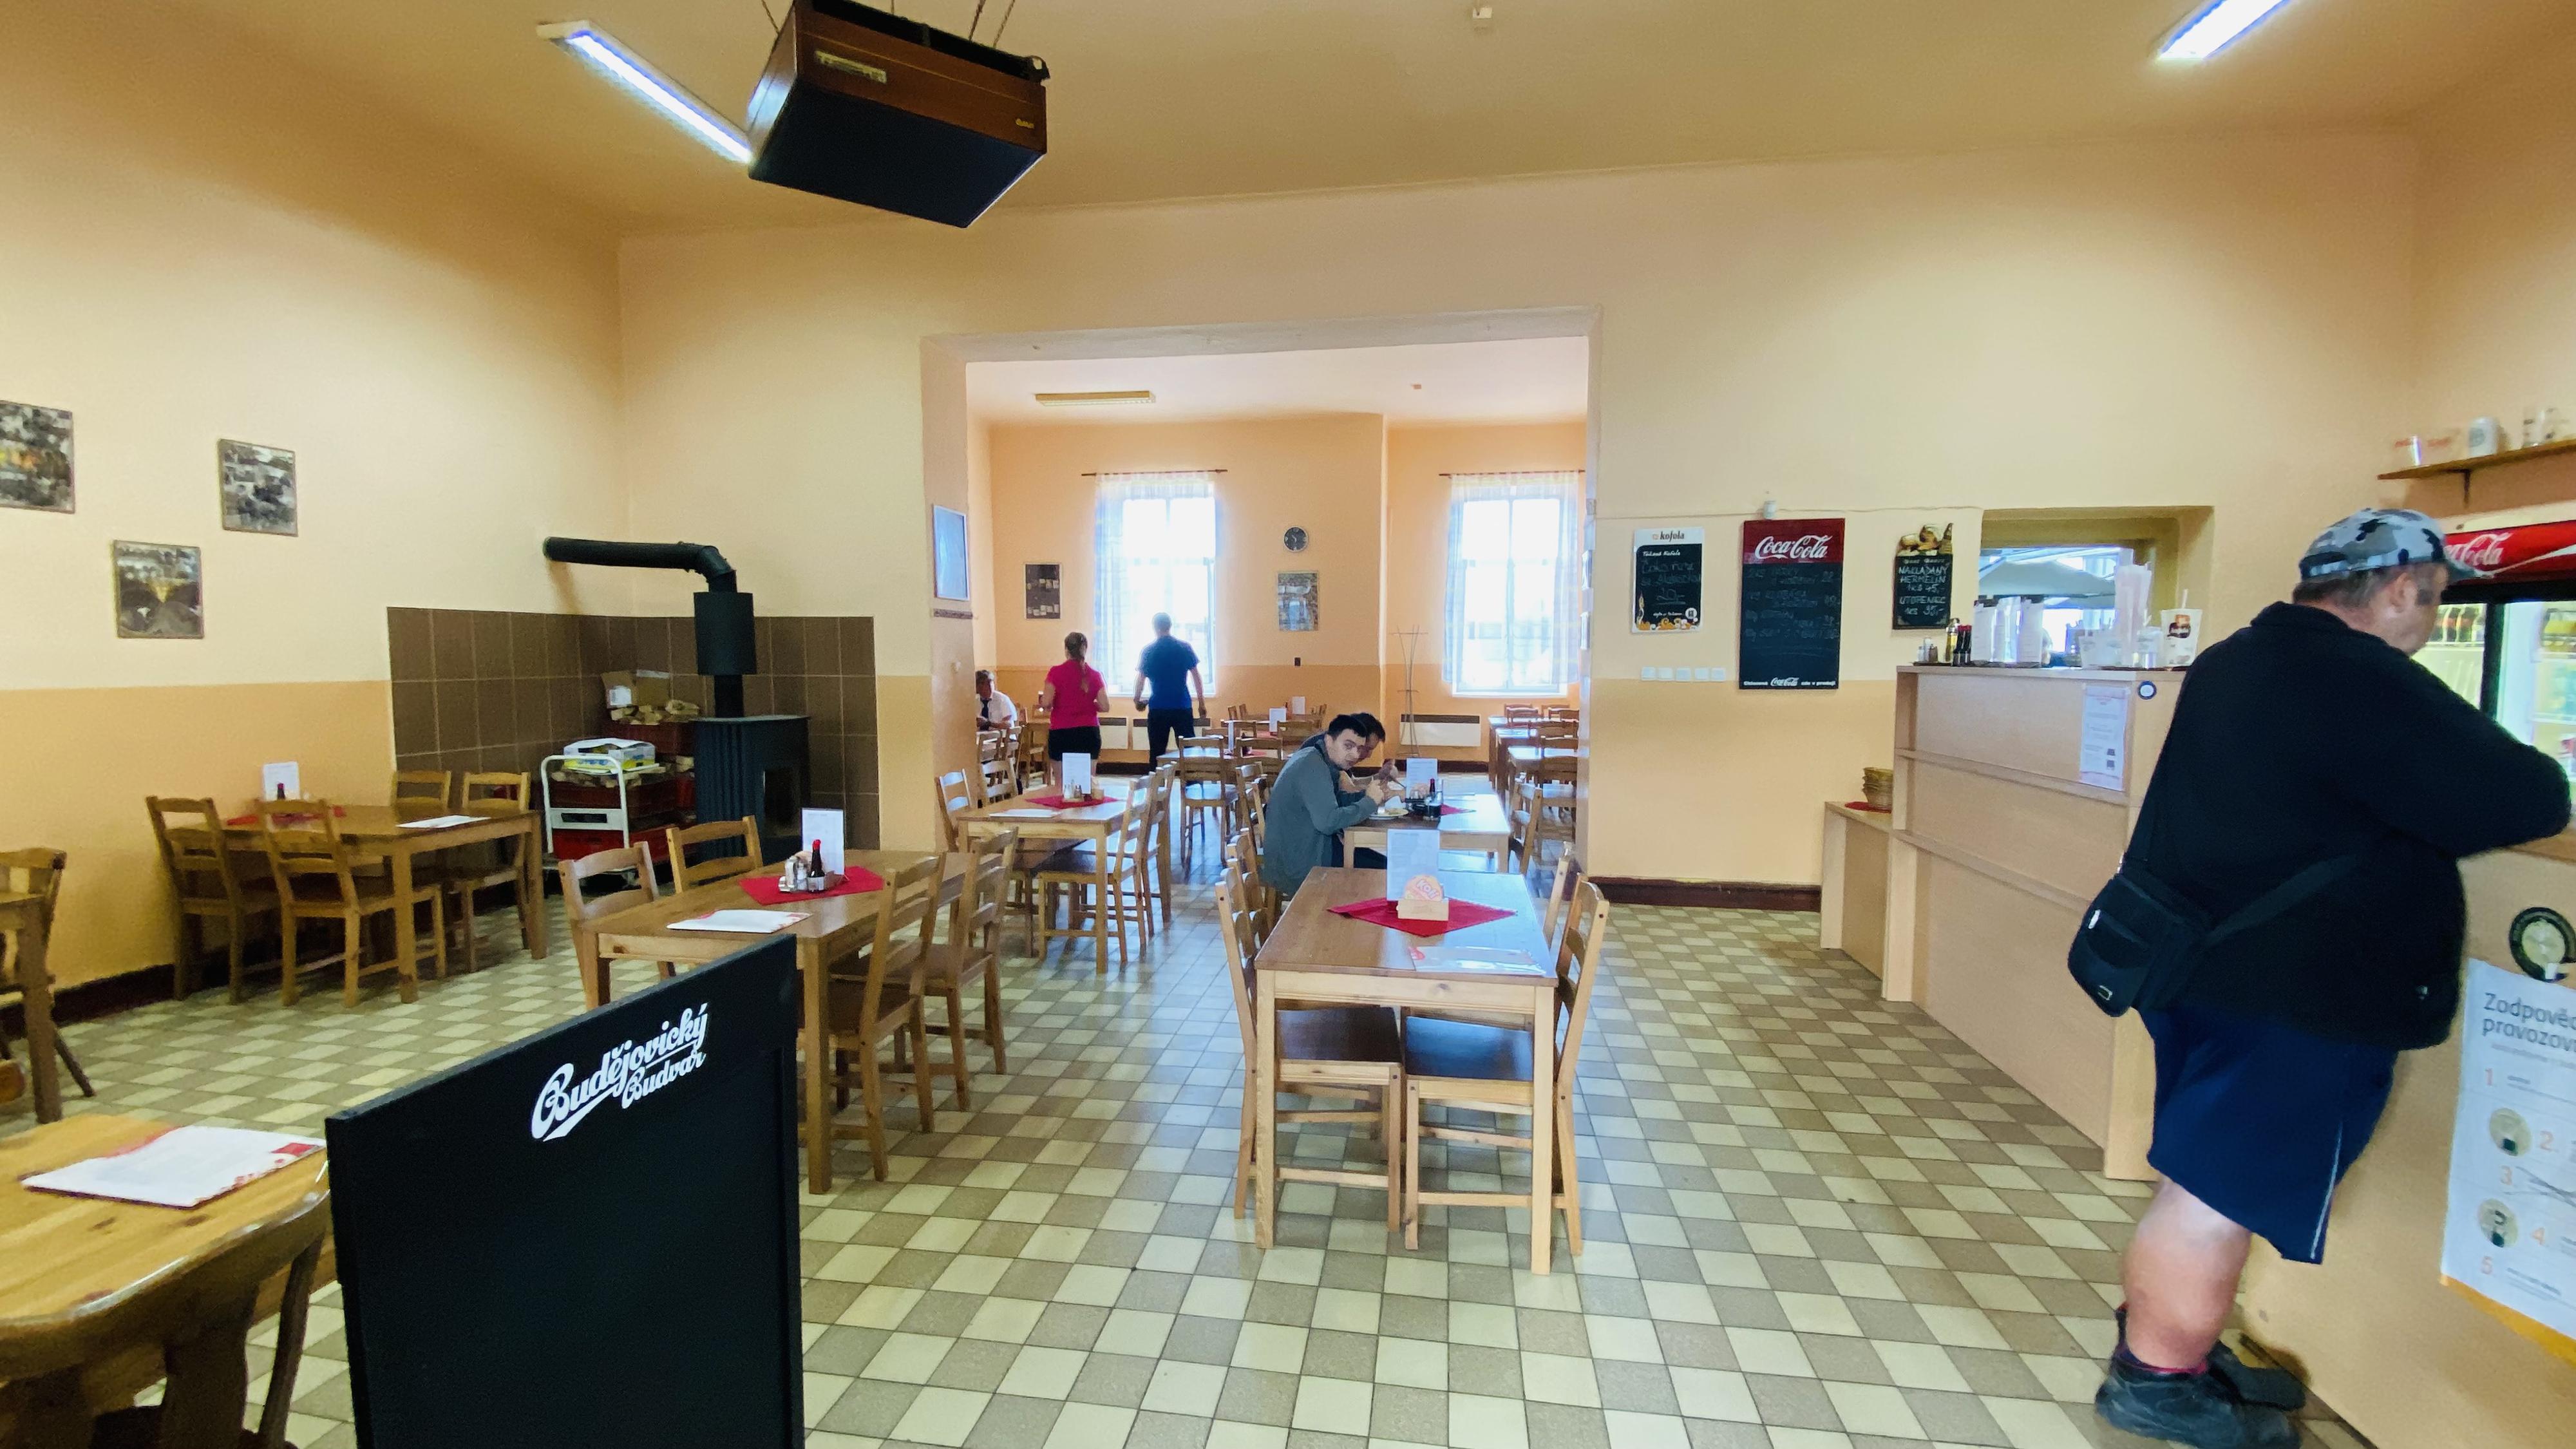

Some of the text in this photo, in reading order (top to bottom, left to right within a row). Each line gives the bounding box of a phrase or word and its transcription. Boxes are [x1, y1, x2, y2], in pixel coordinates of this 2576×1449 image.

[1660, 531, 1685, 542] kofola
[1754, 535, 1833, 559] Coca-Cola
[1770, 677, 1799, 687] Coca-Cola
[2482, 1018, 2576, 1052] provozov
[531, 1002, 709, 1141] Budějovický
[621, 1048, 707, 1109] Budvar
